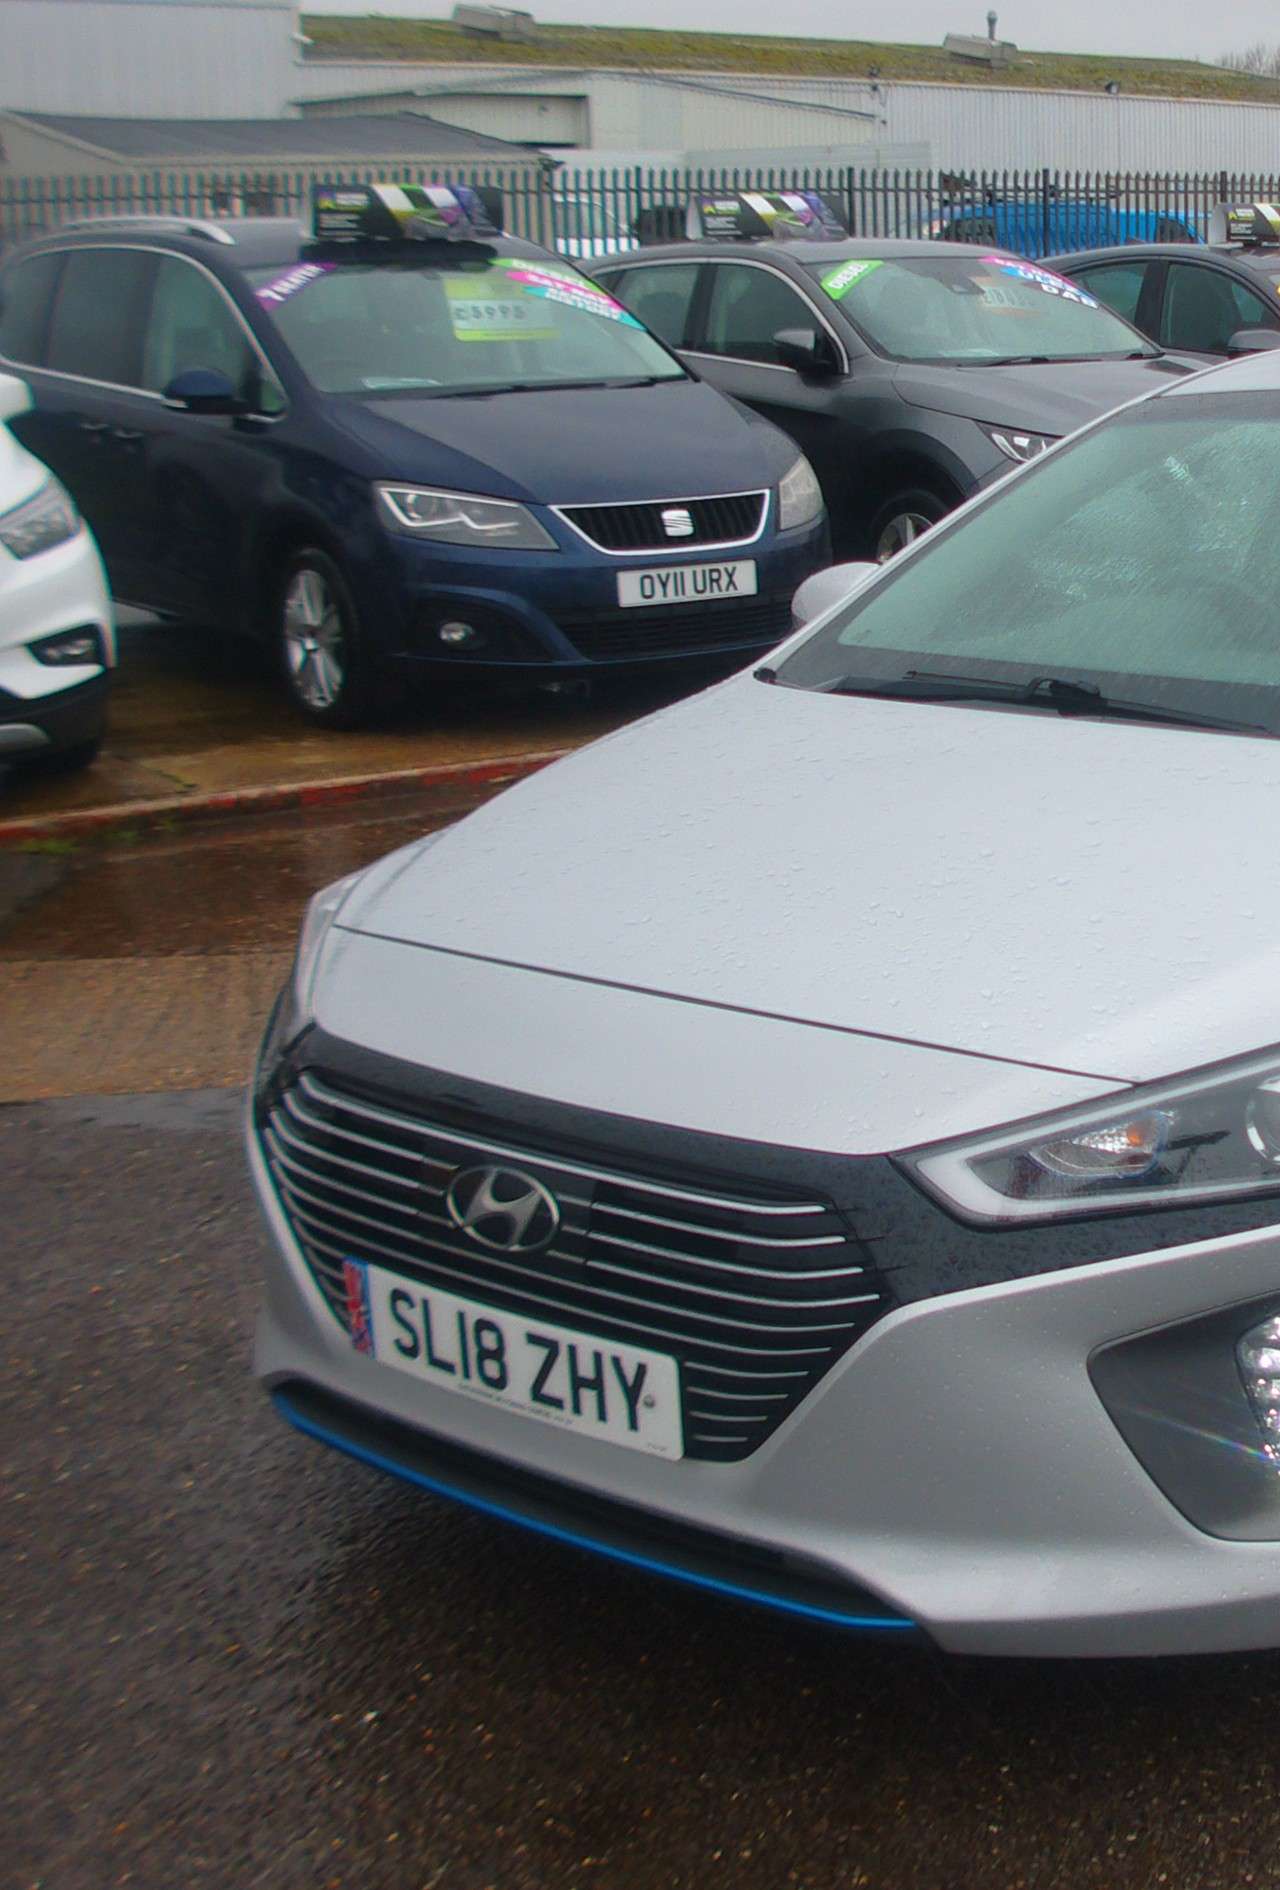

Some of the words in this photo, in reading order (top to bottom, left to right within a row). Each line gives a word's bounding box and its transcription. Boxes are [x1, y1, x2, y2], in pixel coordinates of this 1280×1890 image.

[640, 571, 686, 599] OY11
[692, 566, 738, 595] URX
[389, 1287, 509, 1391] SL18
[525, 1330, 647, 1432] ZHY
